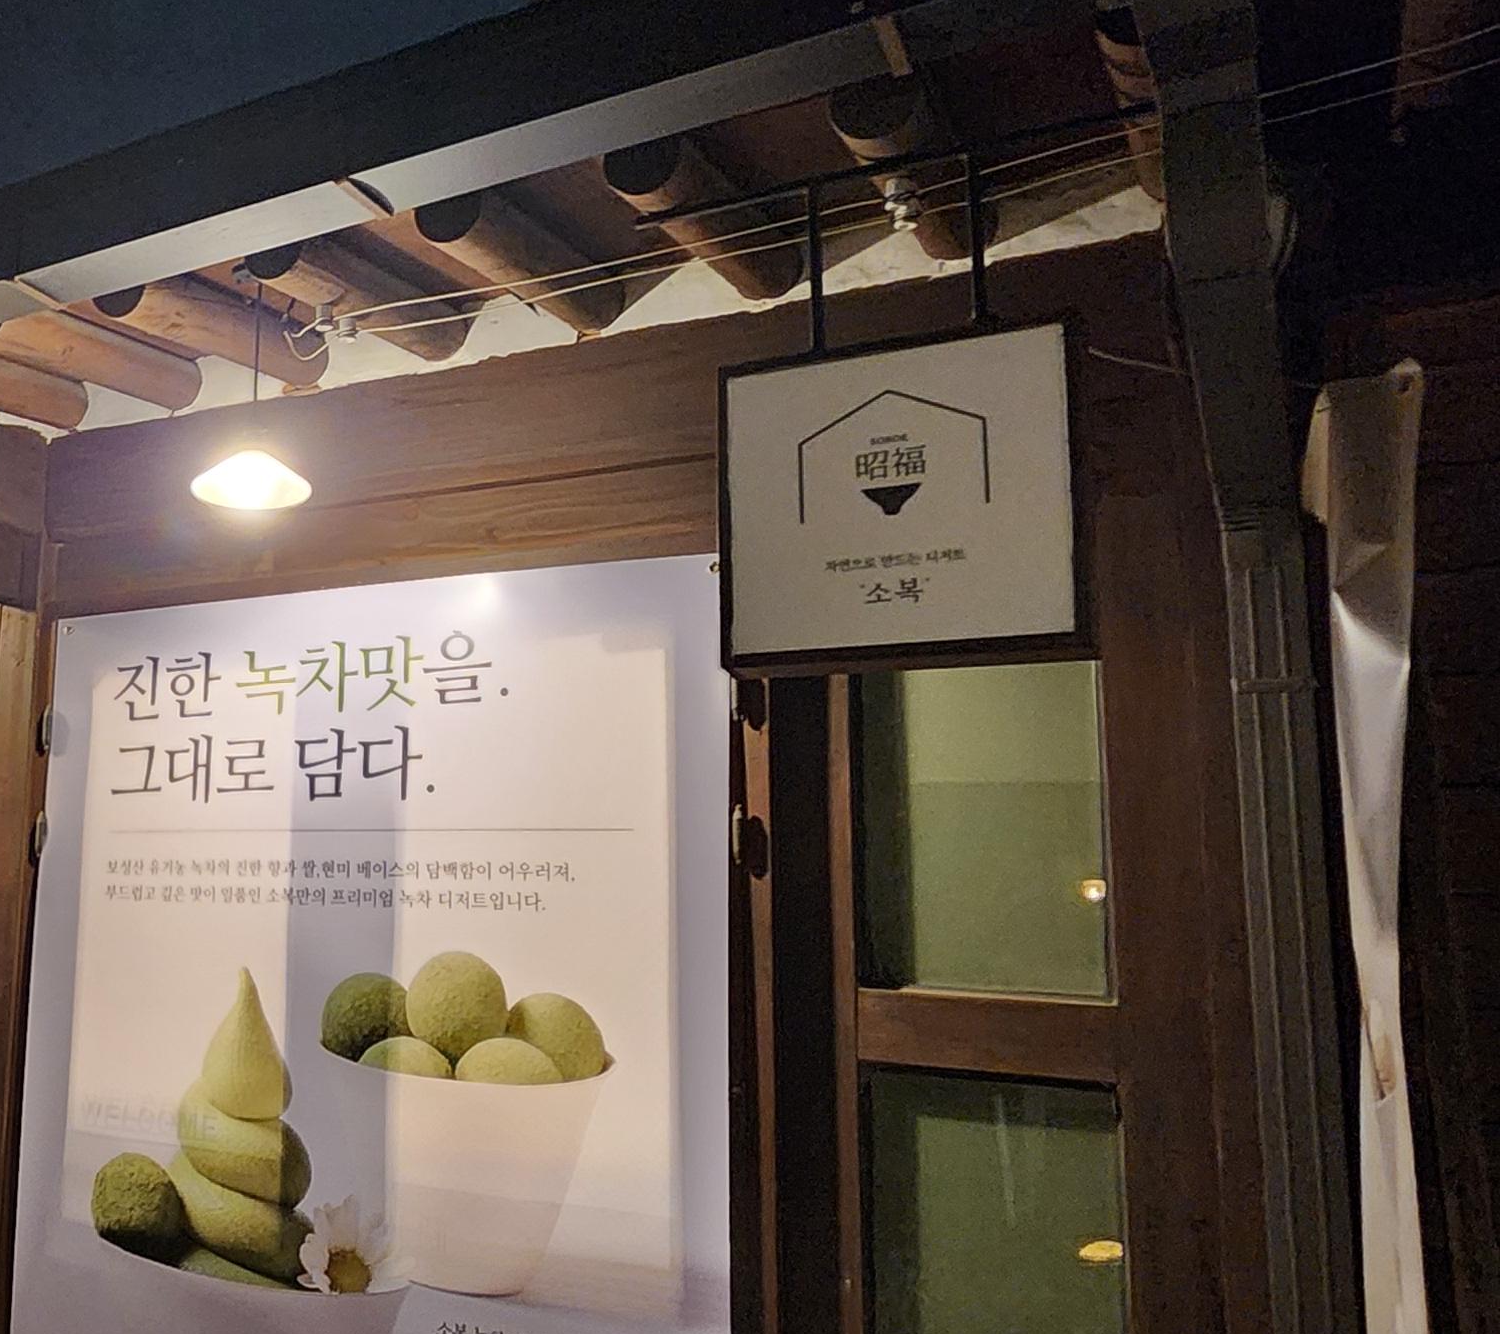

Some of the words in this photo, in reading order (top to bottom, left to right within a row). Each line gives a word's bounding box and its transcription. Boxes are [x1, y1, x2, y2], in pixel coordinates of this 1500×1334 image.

[856, 444, 926, 481] 昭福
[881, 552, 922, 569] 만드는
[114, 651, 221, 721] 진한
[235, 630, 510, 716] 녹차맛을.
[111, 735, 274, 803] 그대로
[296, 726, 435, 802] 담다.
[149, 860, 185, 876] 유기농
[191, 859, 230, 876] 녹차의
[357, 860, 419, 879] 베이스의
[426, 861, 491, 880] 담백함이
[105, 884, 155, 901] 부드럽고
[161, 885, 186, 902] 깊은
[190, 886, 215, 903] 맛이
[221, 886, 260, 904] 일품인
[267, 887, 326, 906] 소복만의
[331, 888, 393, 908] 프리미엄
[399, 890, 432, 909] 녹차
[438, 889, 547, 912] 디저트입니다.
